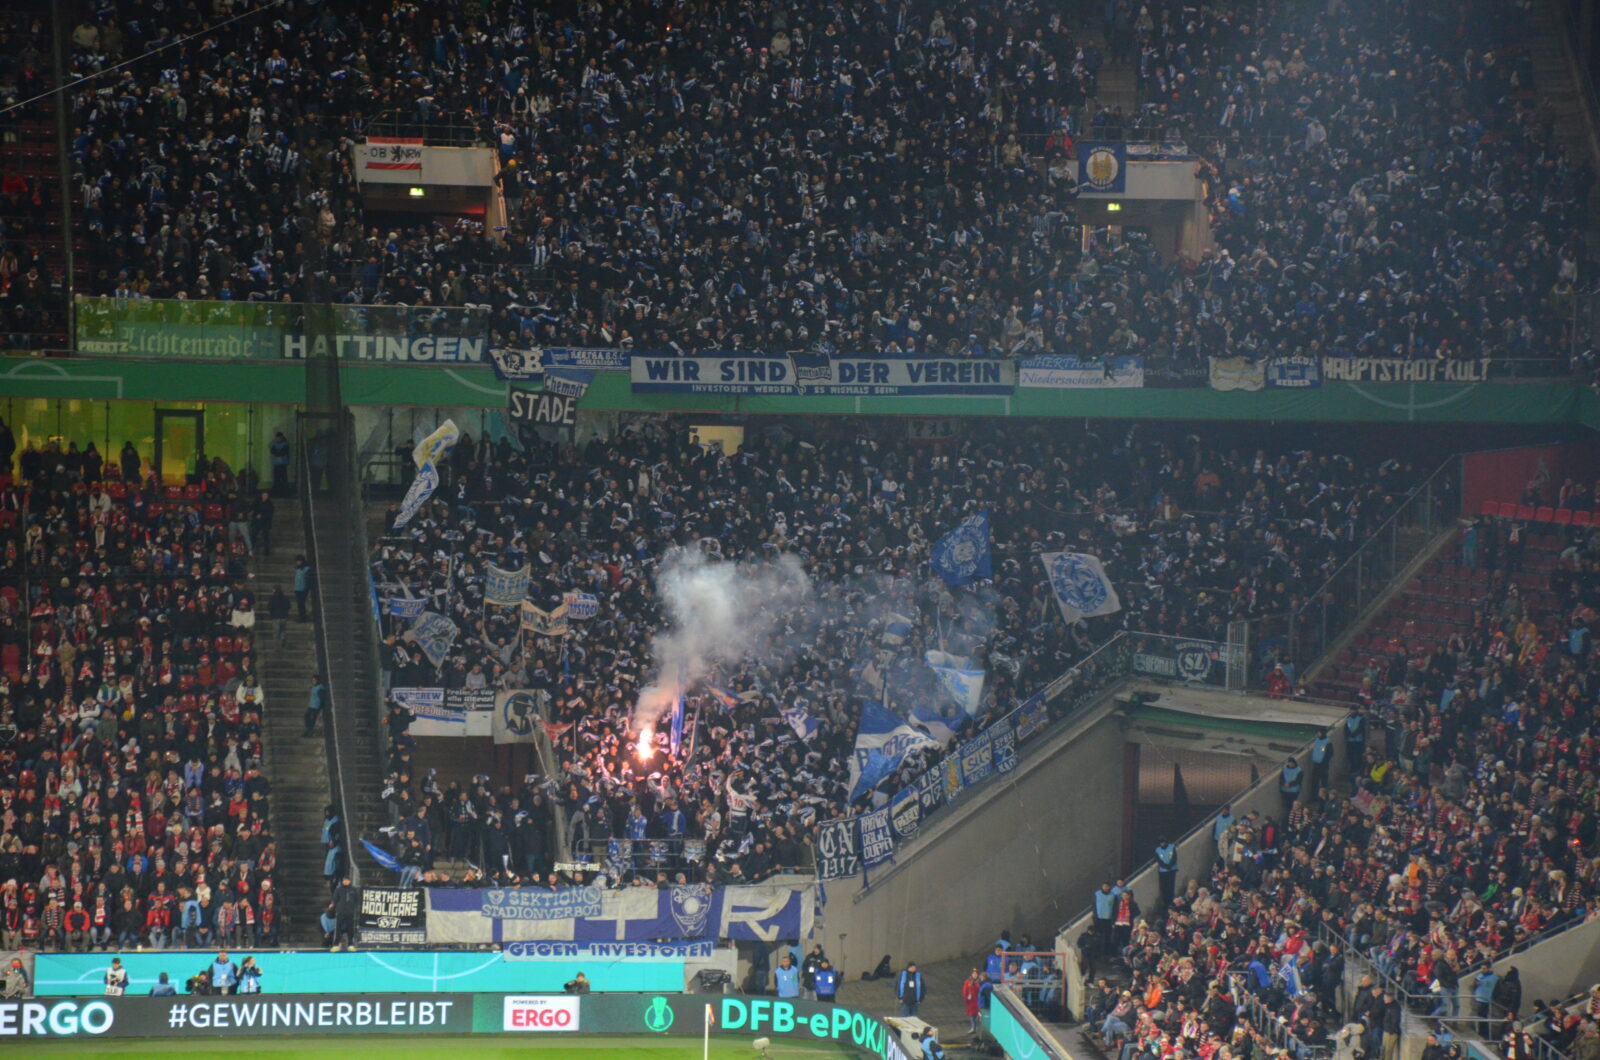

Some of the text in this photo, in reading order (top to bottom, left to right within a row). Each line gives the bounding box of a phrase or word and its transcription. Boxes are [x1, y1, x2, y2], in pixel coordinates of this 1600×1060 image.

[284, 334, 484, 362] HATTINGEN
[645, 360, 787, 382] WIR SIND
[838, 362, 890, 383] DER
[906, 362, 1001, 384] VEREIN
[692, 384, 748, 392] INVESTOREN
[754, 385, 793, 393] WERDEN
[831, 386, 870, 394] NIEMALS
[511, 391, 575, 425] STADE
[362, 889, 420, 903] HERTHA BSC
[508, 888, 583, 907] SEKTION
[361, 901, 419, 917] HOOLIGANS
[482, 904, 600, 919] STADIONVERBOT
[508, 941, 714, 958] GEGEN INVESTOREN
[0, 1001, 114, 1035] ERGO
[168, 1000, 453, 1029] #GEWINNERBLEIBT
[511, 1008, 571, 1027] ERGO
[720, 998, 887, 1060] DFB-ePOKAL
